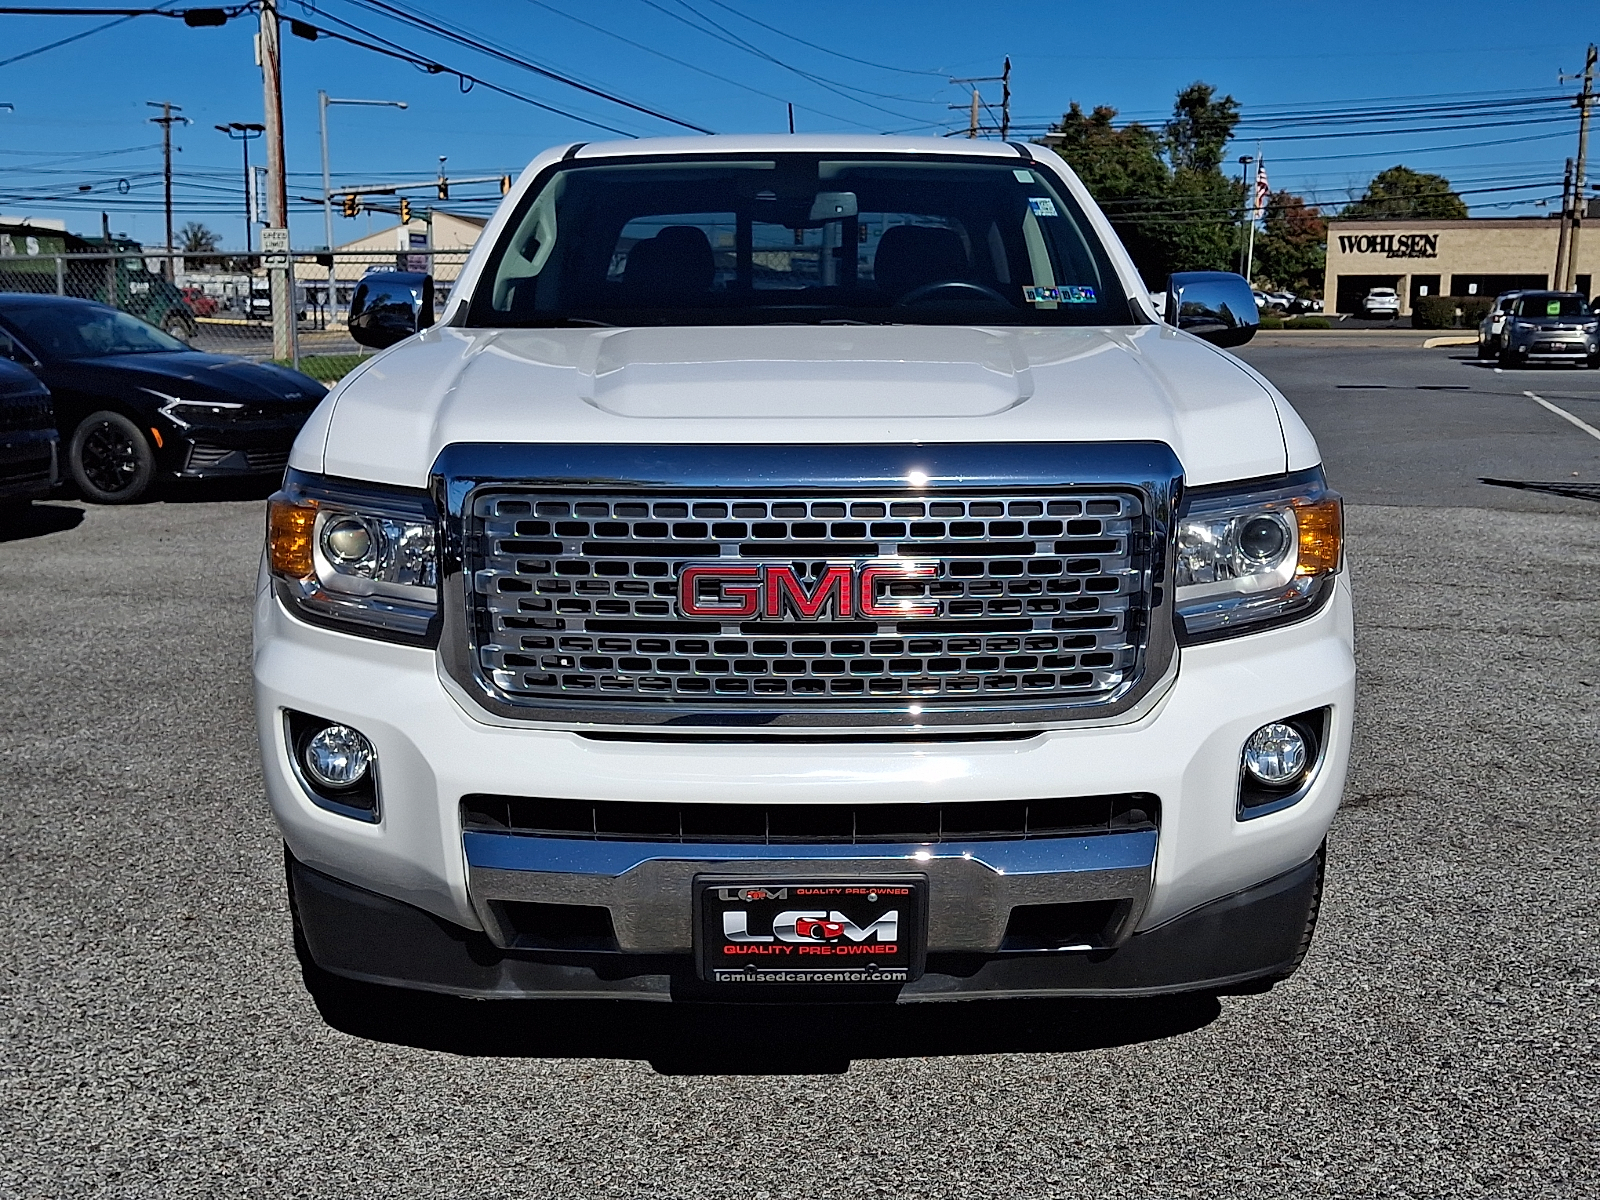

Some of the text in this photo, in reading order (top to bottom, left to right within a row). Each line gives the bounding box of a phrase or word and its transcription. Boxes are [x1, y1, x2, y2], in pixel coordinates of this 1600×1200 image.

[263, 231, 287, 239] SPEED
[265, 240, 284, 249] LIMIT
[1338, 234, 1439, 254] WOHLSEN
[677, 560, 940, 622] GMC
[845, 888, 909, 896] PRE-OWNED
[722, 910, 899, 943] LCM
[723, 944, 898, 955] QUALITY PRE-OWNED
[715, 971, 907, 982] lcmusedcarcenter.com
